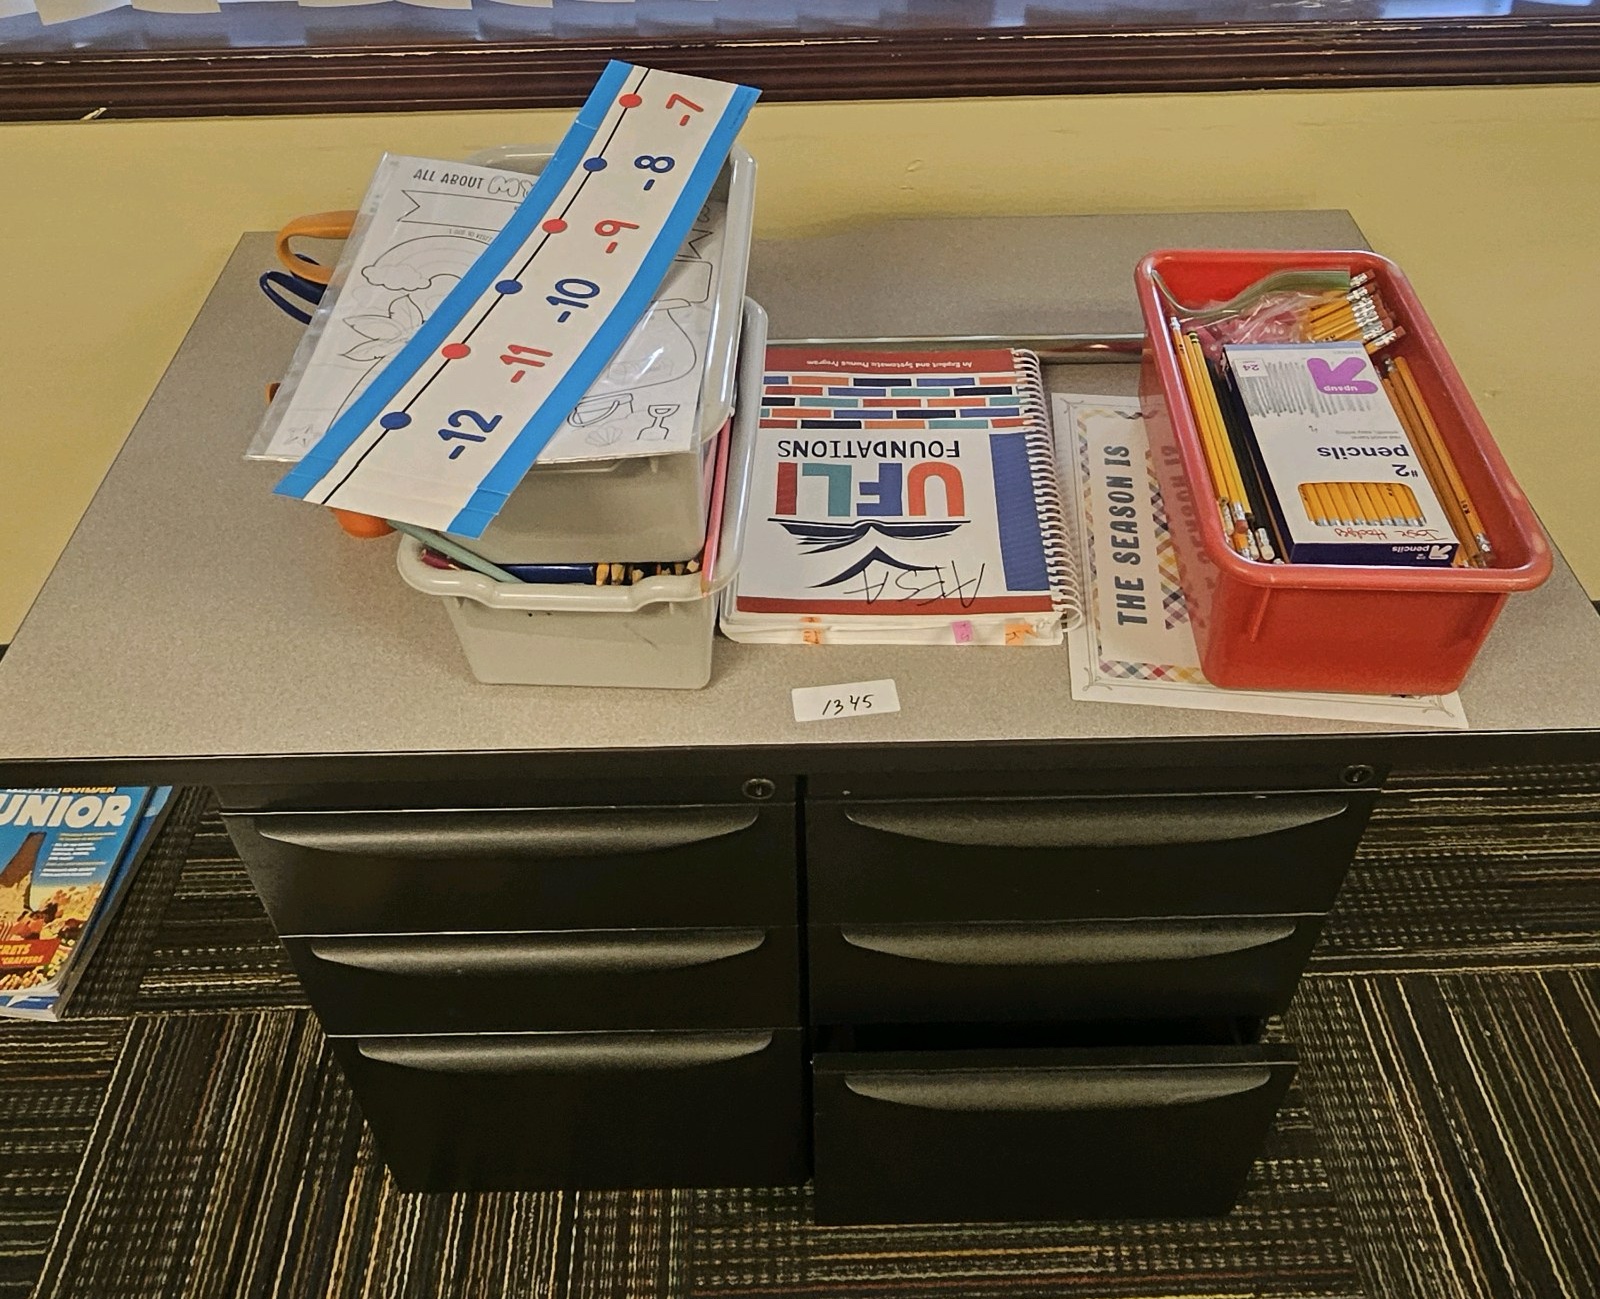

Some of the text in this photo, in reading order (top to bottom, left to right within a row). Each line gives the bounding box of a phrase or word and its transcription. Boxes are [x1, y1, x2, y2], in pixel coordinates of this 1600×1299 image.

[665, 93, 705, 127] -7
[413, 168, 437, 182] ALL
[440, 173, 485, 189] ABOUT
[633, 155, 675, 192] -8
[594, 219, 640, 255] -9
[546, 277, 601, 324] -10
[499, 344, 554, 384] -11
[1242, 363, 1260, 372] 24
[437, 408, 503, 461] -12
[777, 439, 960, 459] FOUNDATIONS
[1316, 443, 1409, 460] pencils
[1391, 463, 1418, 478] #2
[775, 461, 966, 517] UFLI
[1103, 445, 1149, 627] THE SEASON IS
[1391, 544, 1430, 553] pencils
[822, 694, 874, 716] 1345
